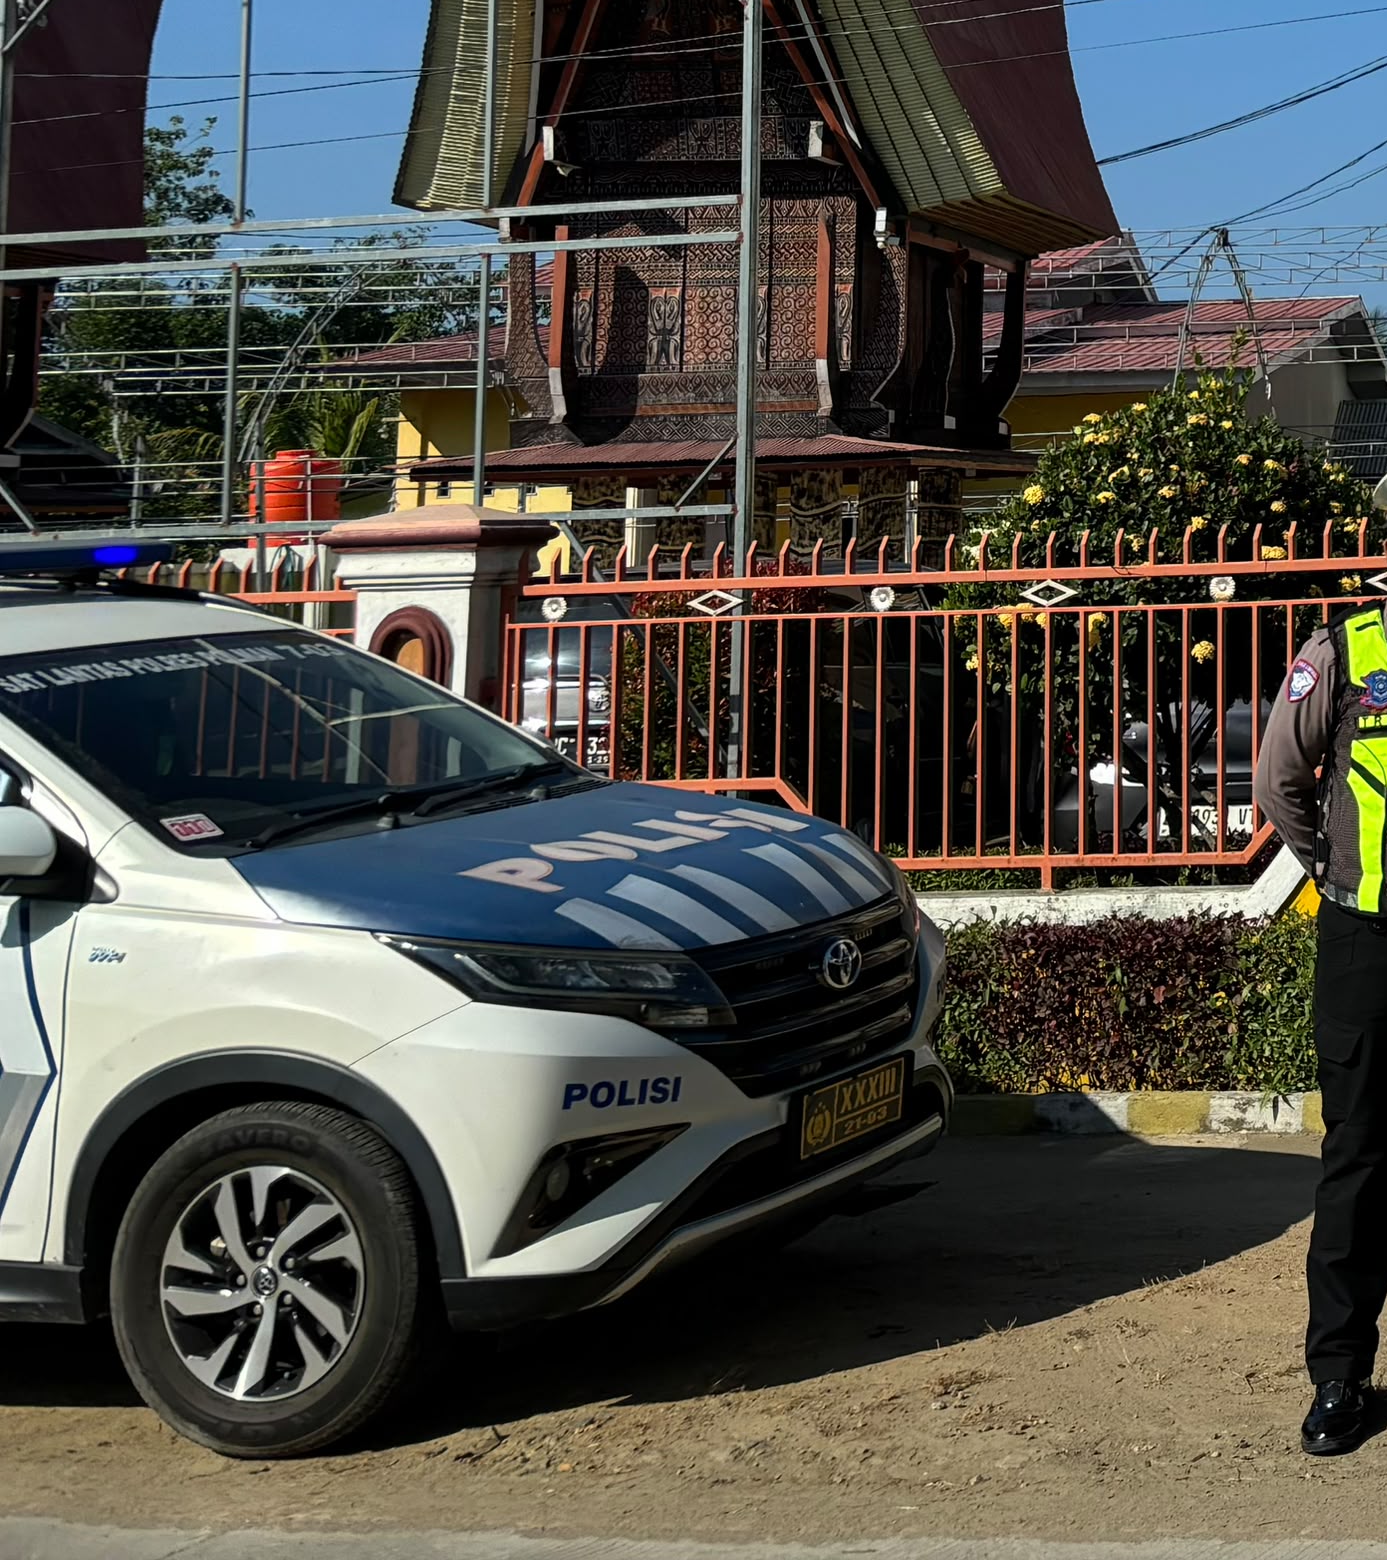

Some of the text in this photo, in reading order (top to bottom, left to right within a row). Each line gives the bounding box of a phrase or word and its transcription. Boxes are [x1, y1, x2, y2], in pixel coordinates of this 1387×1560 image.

[0, 671, 48, 694] SAT
[44, 659, 133, 687] LANTAS
[456, 807, 811, 893] POLISI
[562, 1076, 682, 1110] POLISI
[840, 1066, 896, 1114] XXXIII
[844, 1106, 888, 1135] 21-03
